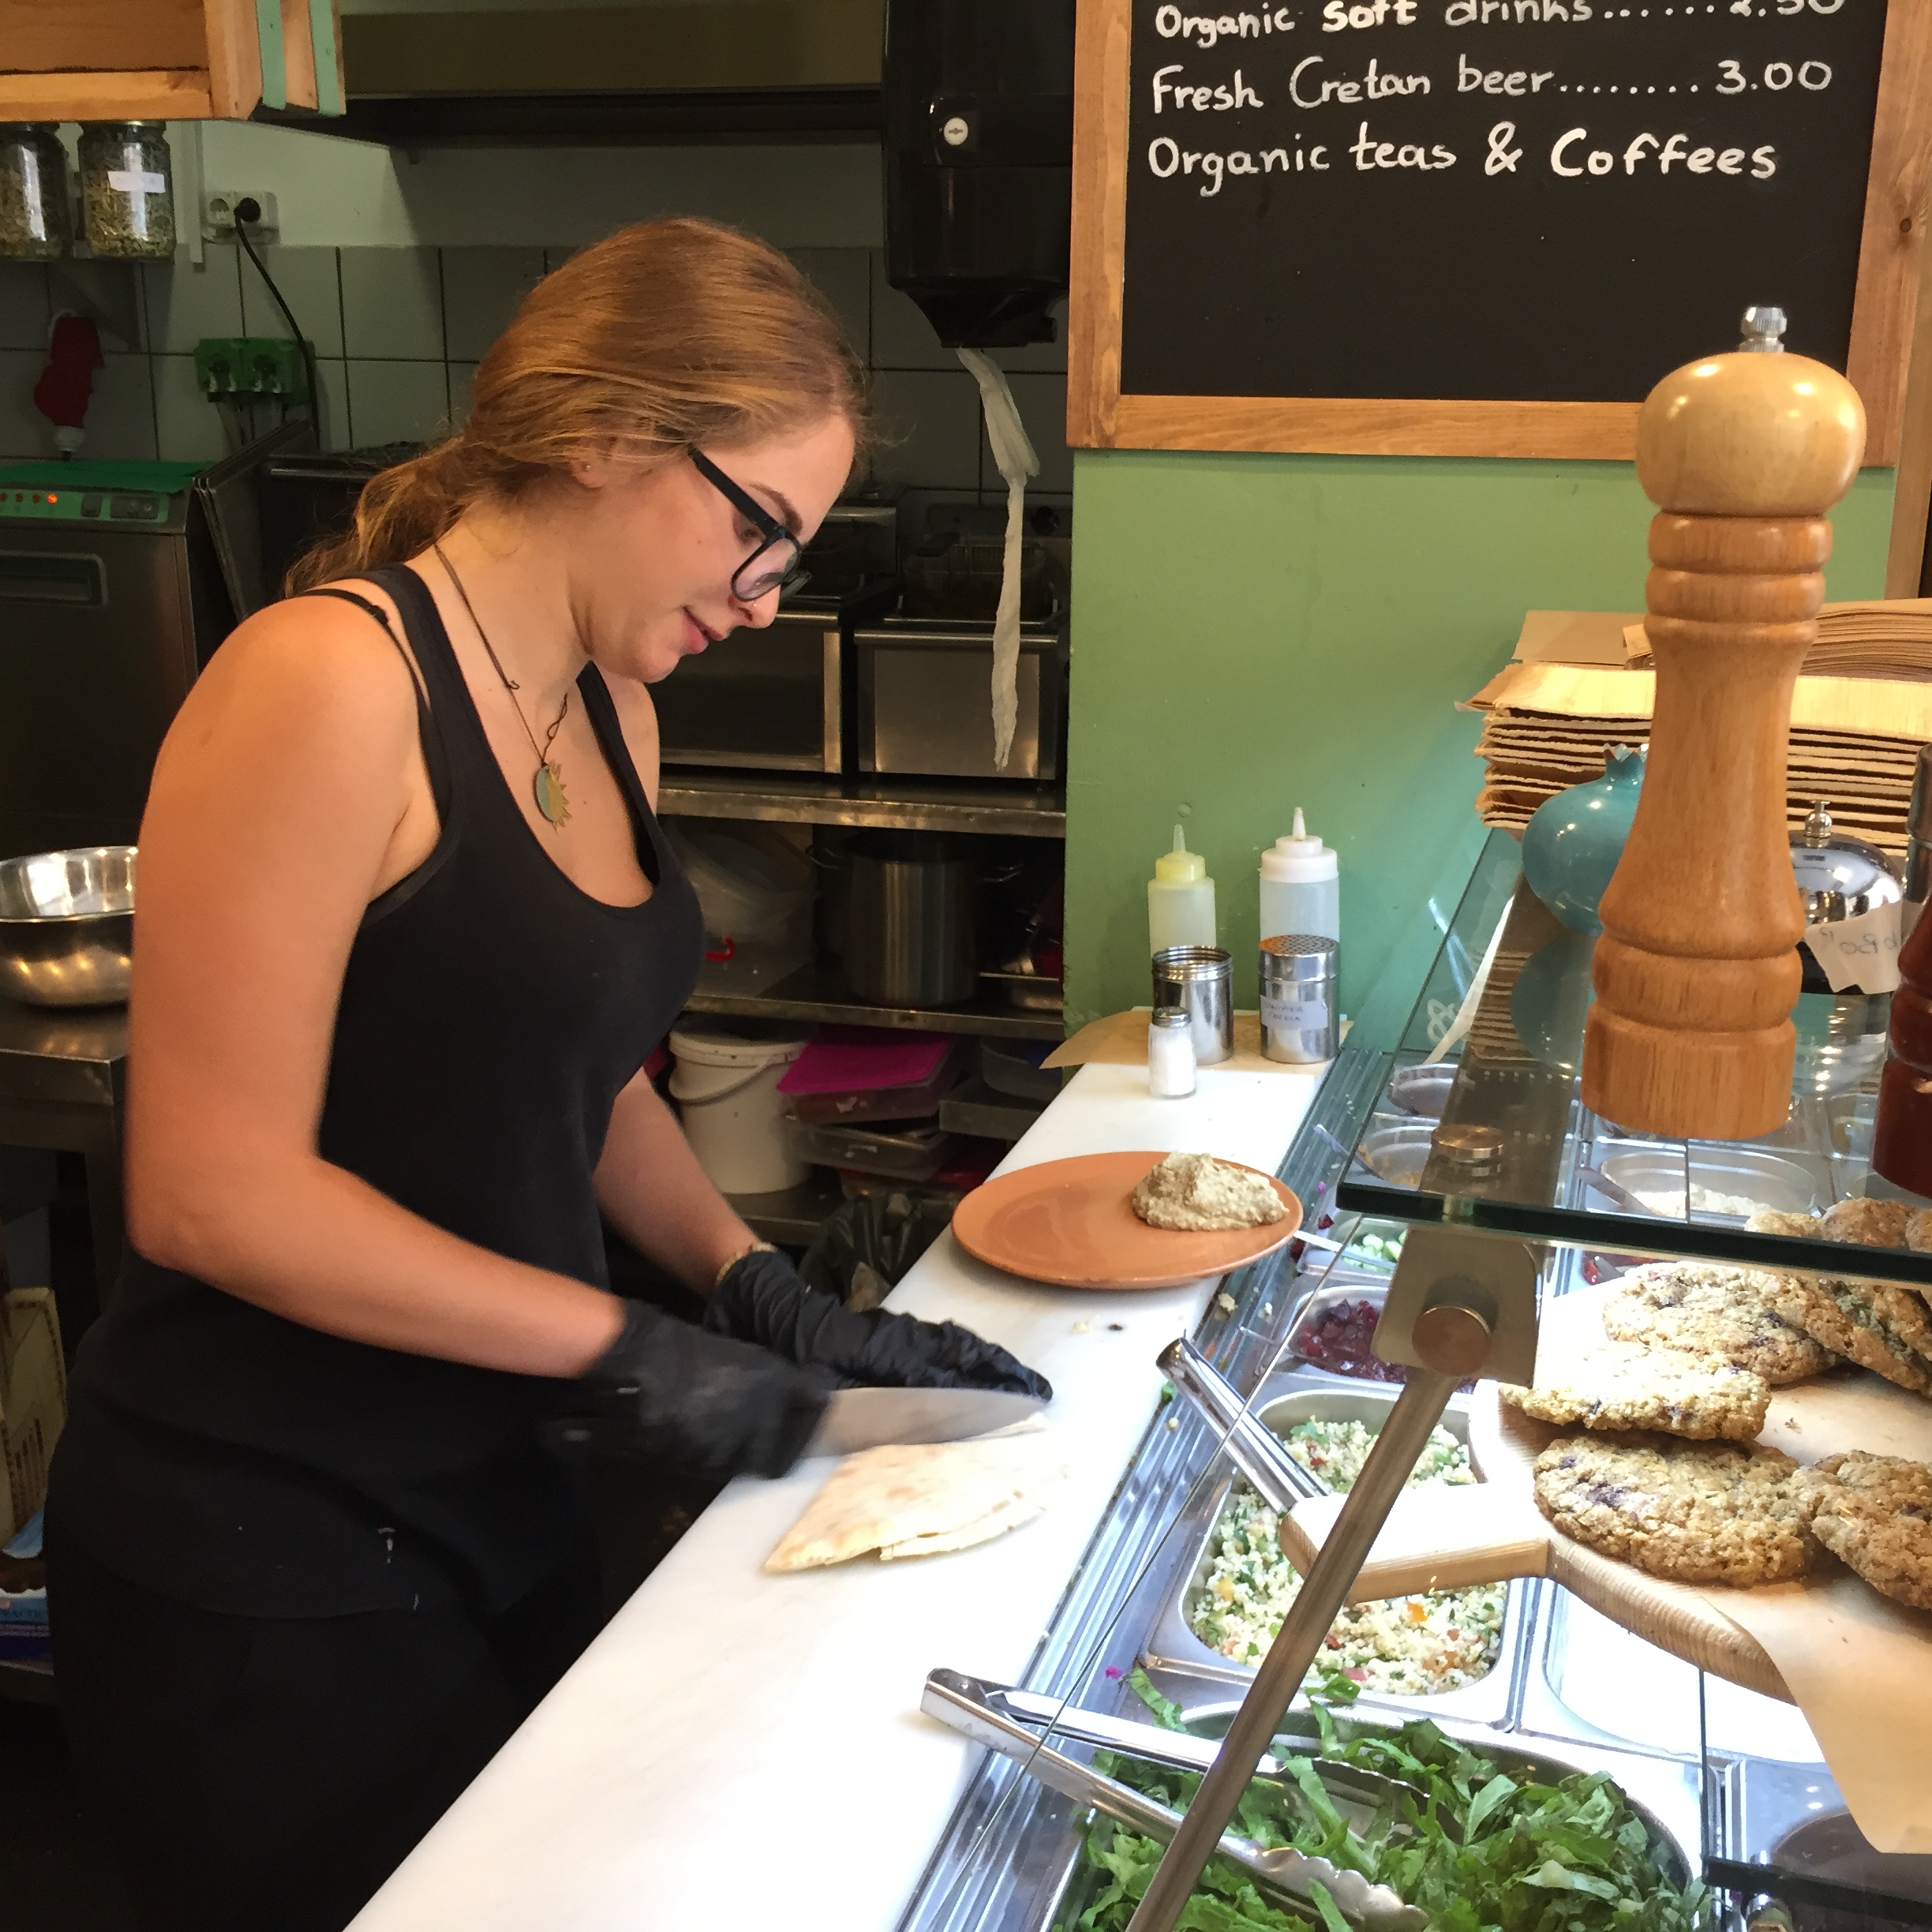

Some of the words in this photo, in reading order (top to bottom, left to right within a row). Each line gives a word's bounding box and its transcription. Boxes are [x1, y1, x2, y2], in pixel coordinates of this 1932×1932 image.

[1155, 2, 1295, 48] Organic
[1153, 65, 1264, 114] Fresh
[1290, 56, 1430, 108] Cretan
[1716, 60, 1832, 94] 3.00
[1148, 133, 1329, 197] Organic
[1349, 122, 1456, 170] teas
[1485, 122, 1523, 175] &
[1551, 128, 1776, 178] Coffees
